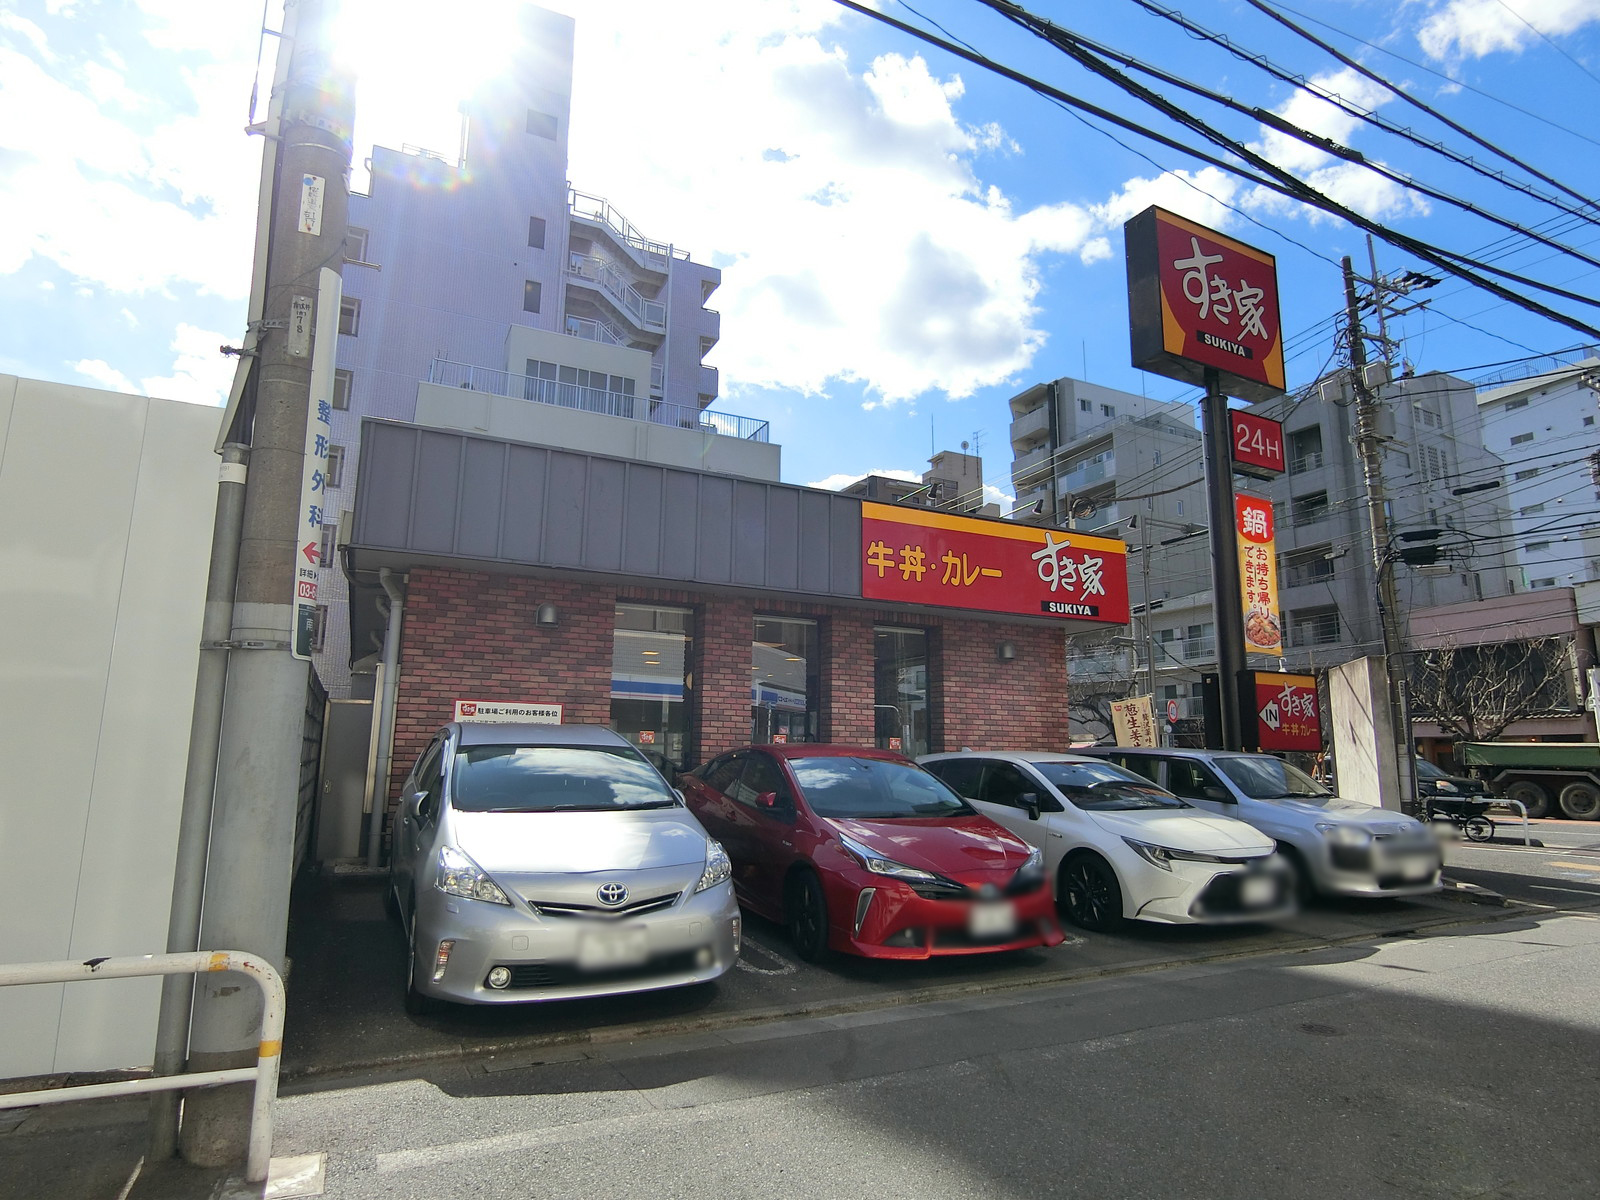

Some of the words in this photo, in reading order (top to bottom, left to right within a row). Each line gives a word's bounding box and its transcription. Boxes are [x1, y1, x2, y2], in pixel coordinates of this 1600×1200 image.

[1173, 235, 1268, 342] すき家
[1203, 332, 1246, 357] SUKIYA
[1236, 423, 1280, 460] 24H
[308, 400, 331, 531] 整形外科
[1242, 506, 1268, 539] 鍋
[867, 540, 1003, 587] 牛丼・カレー
[1031, 532, 1106, 602] すき家
[1244, 545, 1257, 609] できます。
[1256, 547, 1271, 620] お持ち帰り
[1048, 602, 1092, 616] SUKIYA
[477, 707, 558, 718] 駐車場ご利用のお客様各位
[1265, 708, 1278, 722] IN
[1277, 681, 1316, 722] すき家
